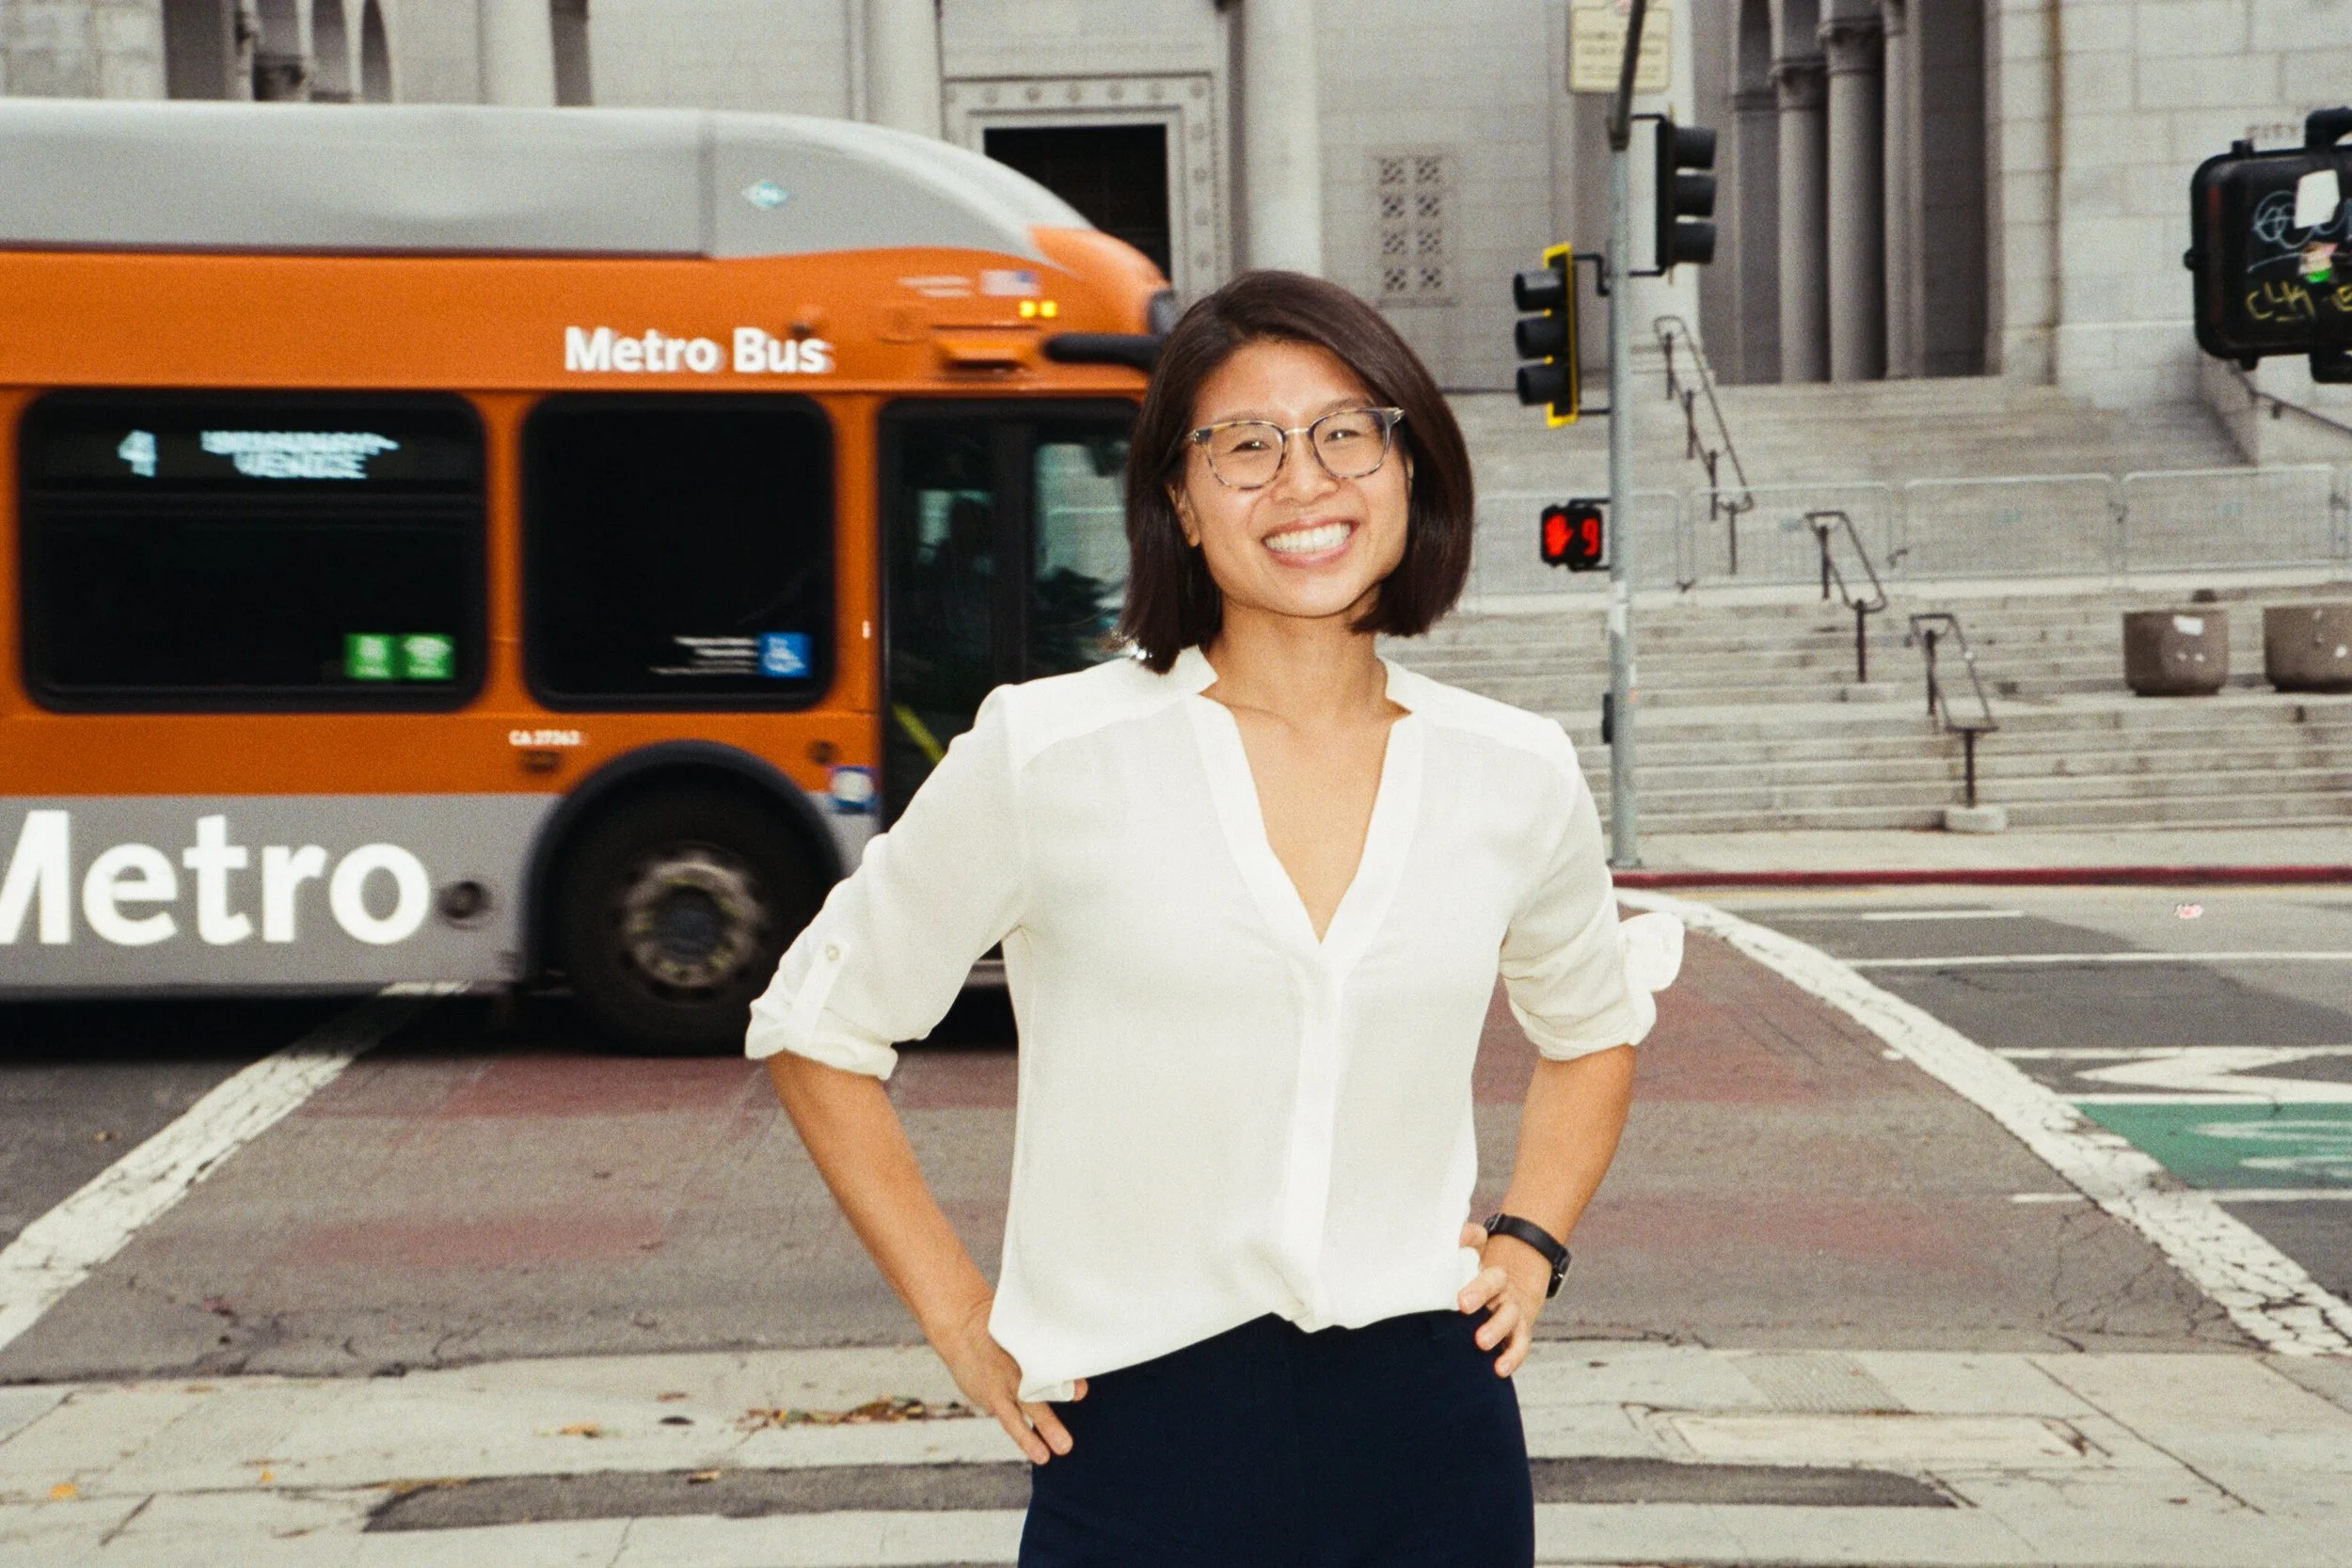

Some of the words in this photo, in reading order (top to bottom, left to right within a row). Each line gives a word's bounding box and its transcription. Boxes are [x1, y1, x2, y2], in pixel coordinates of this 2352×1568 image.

[564, 325, 721, 373] Metro
[733, 326, 834, 373] Bus
[118, 429, 157, 477] 4
[1581, 517, 1599, 556] 9
[0, 810, 430, 944] Metro
